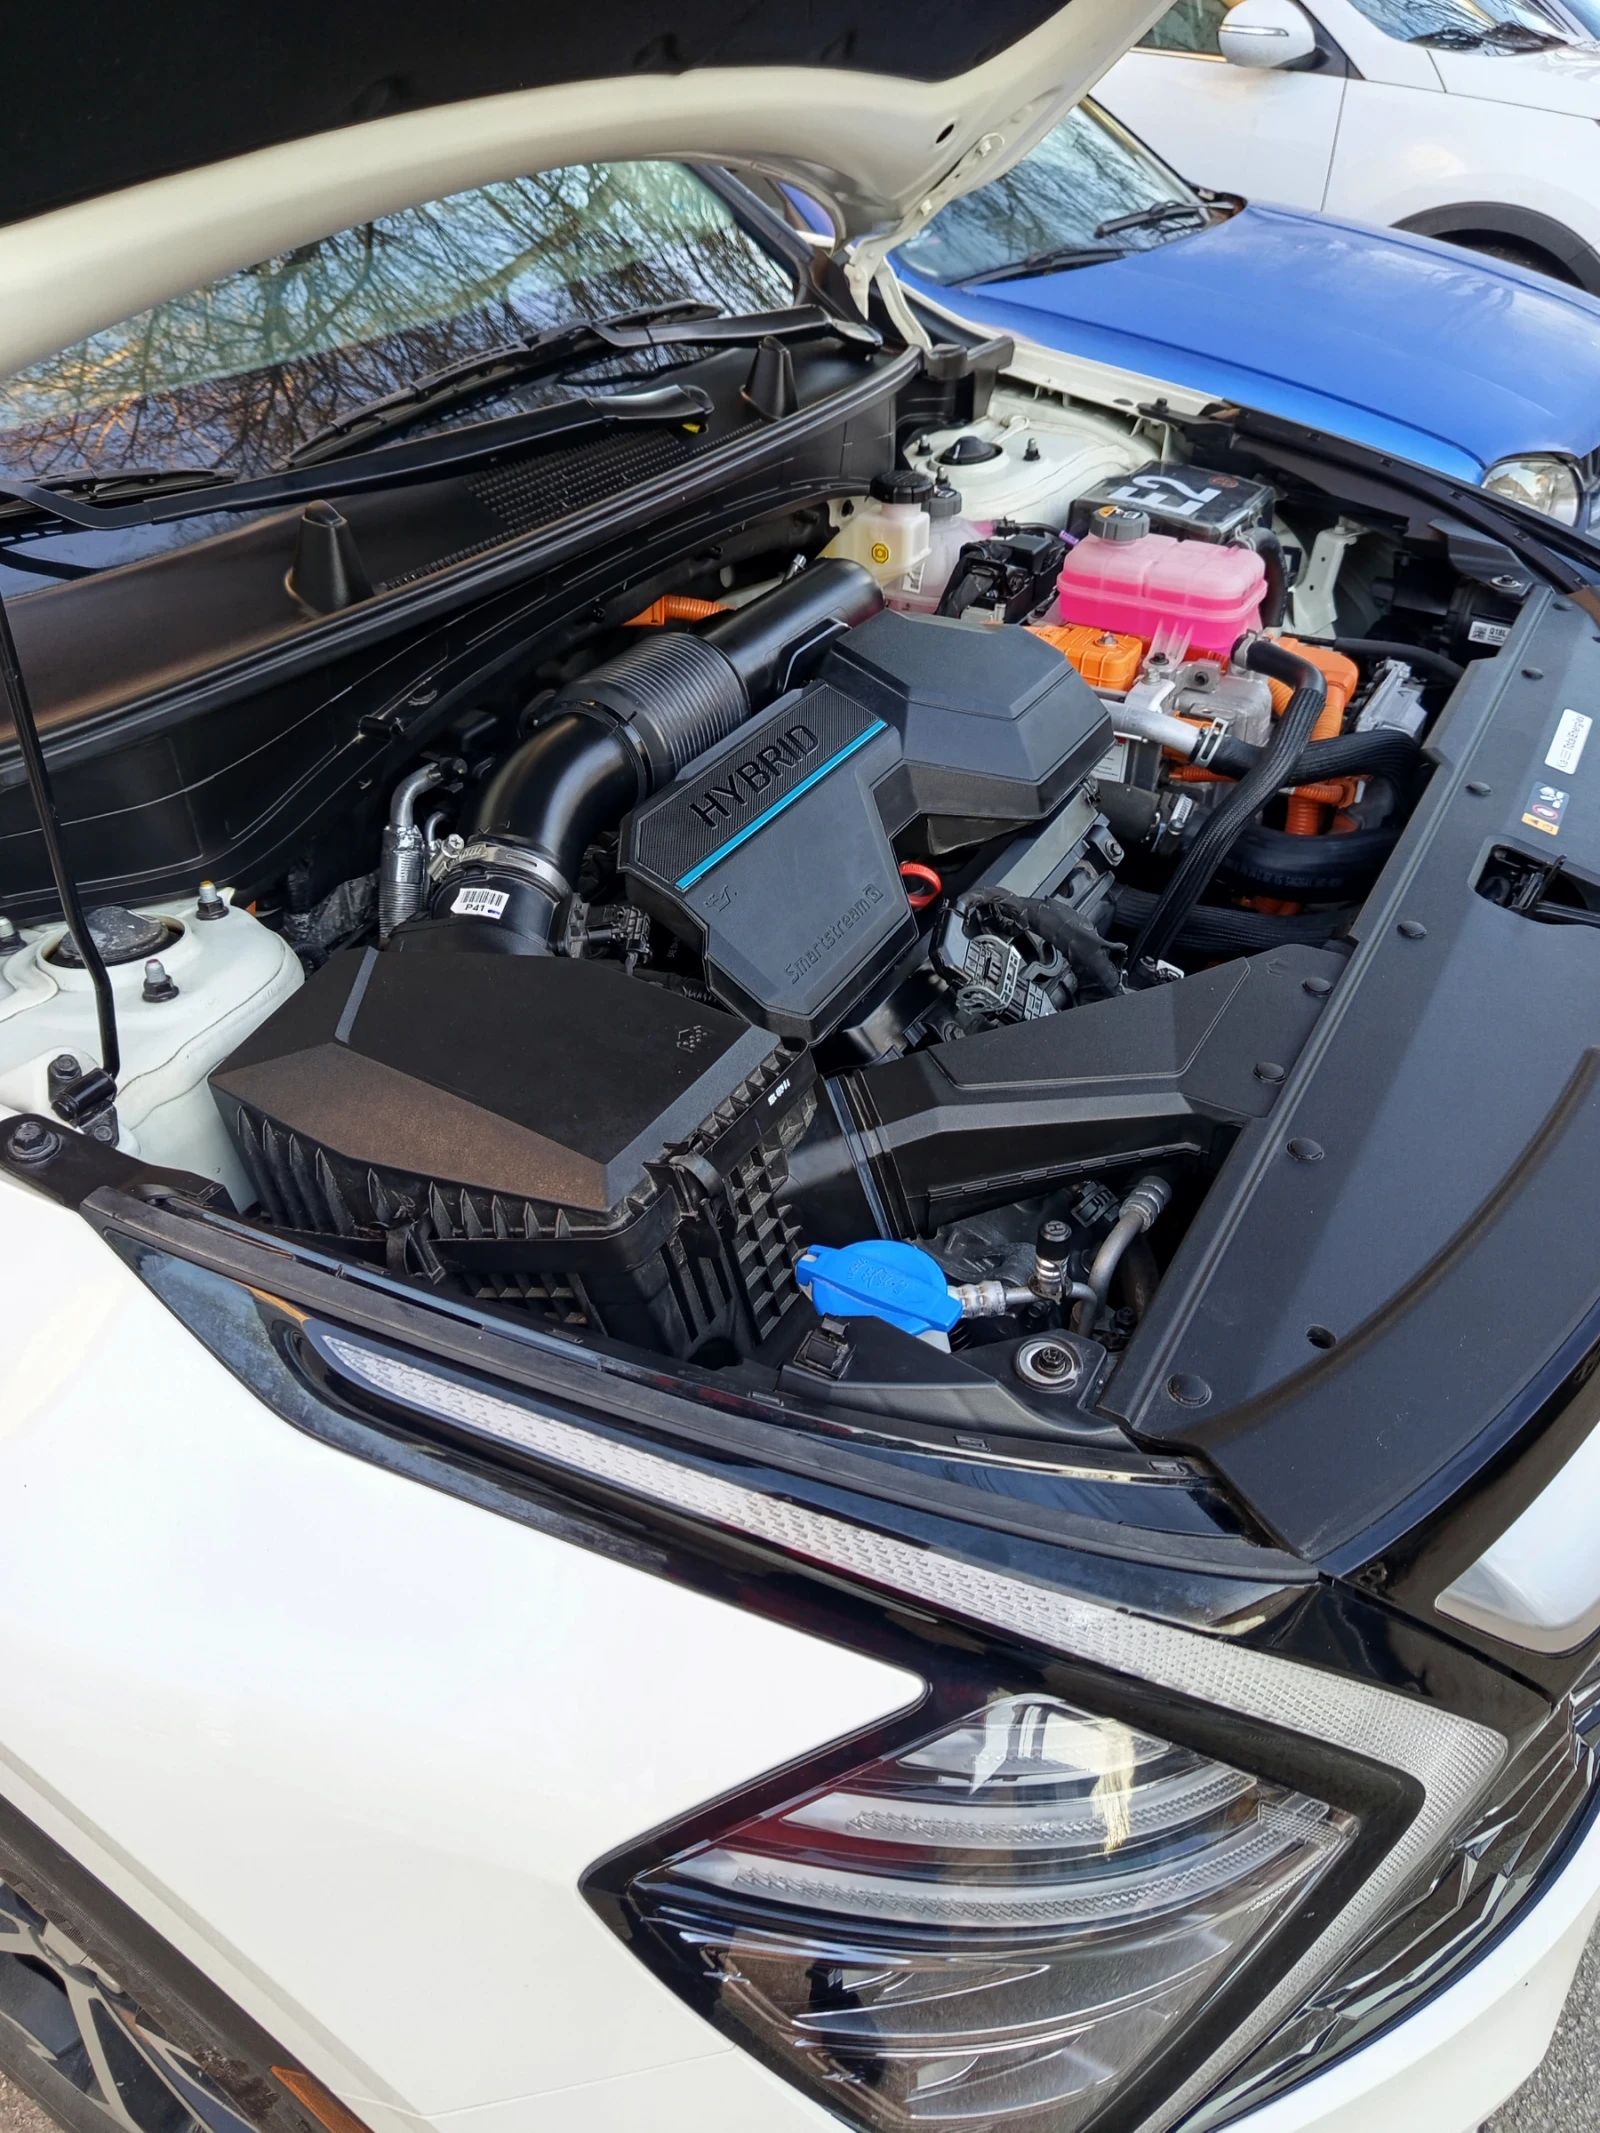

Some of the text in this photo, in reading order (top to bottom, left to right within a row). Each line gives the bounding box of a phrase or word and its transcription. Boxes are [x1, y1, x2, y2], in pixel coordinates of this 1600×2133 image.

[1108, 475, 1221, 516] E2
[689, 725, 819, 830] HYBRID
[464, 903, 486, 912] P41
[784, 898, 871, 985] Smartstream
[1047, 1222, 1064, 1232] H
